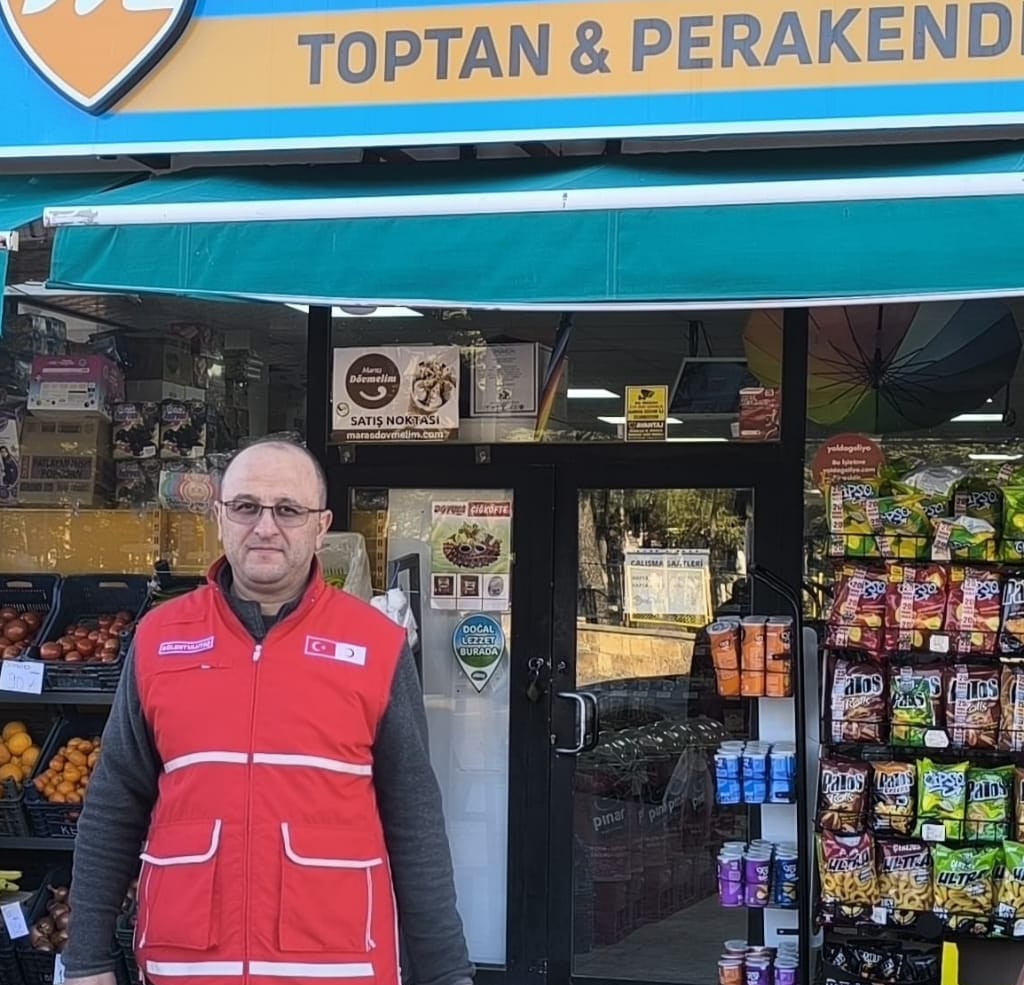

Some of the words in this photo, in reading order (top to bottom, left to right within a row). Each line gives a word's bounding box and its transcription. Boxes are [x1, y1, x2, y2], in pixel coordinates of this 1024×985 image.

[298, 24, 550, 85] TOPTAN
[570, 20, 611, 74] &
[632, 2, 1024, 72] PERAKEND
[351, 415, 384, 428] SATIŞ
[462, 624, 495, 634] DOĞAL
[462, 636, 496, 645] LEZZET
[460, 647, 499, 656] BURADA
